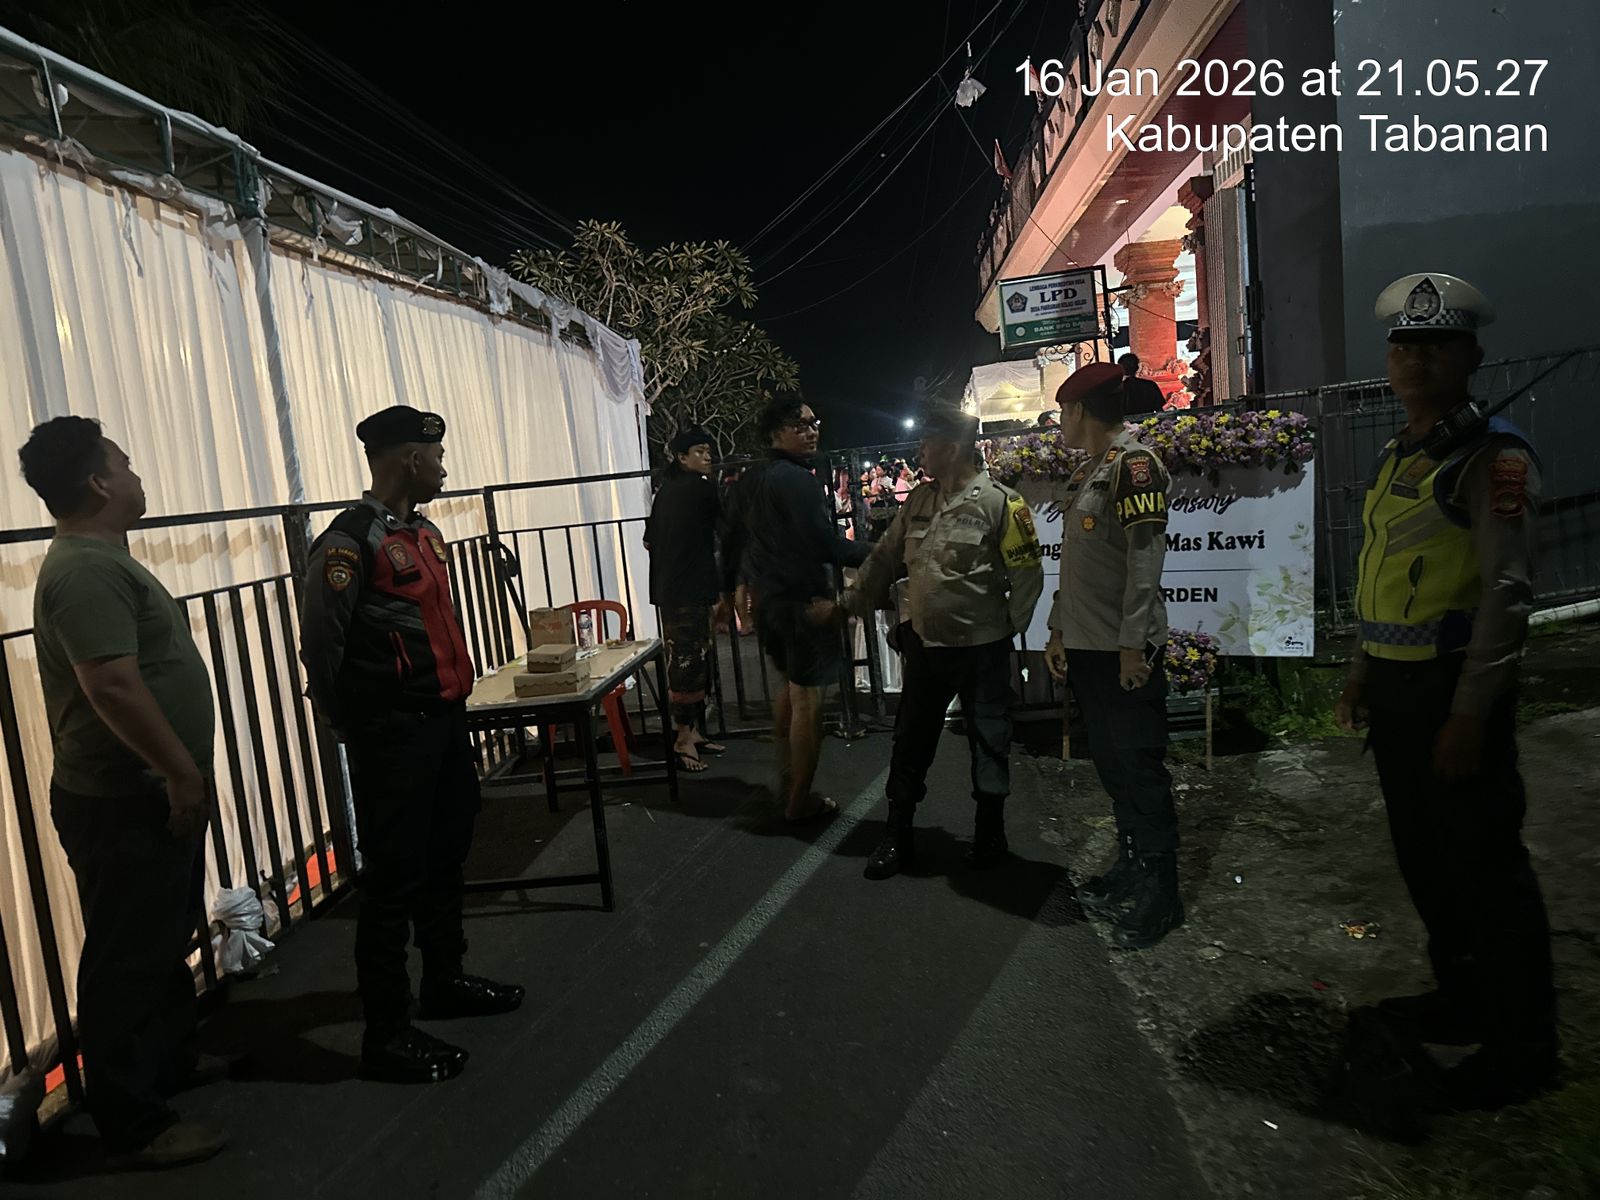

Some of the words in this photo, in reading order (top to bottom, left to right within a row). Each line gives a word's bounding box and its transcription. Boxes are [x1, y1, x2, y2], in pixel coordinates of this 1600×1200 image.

[1039, 288, 1077, 303] LPD
[1034, 325, 1055, 333] BANK
[1168, 494, 1239, 515] ersary
[1165, 532, 1202, 552] Mas
[1207, 530, 1265, 551] Kawi
[1162, 587, 1218, 603] RDEN
